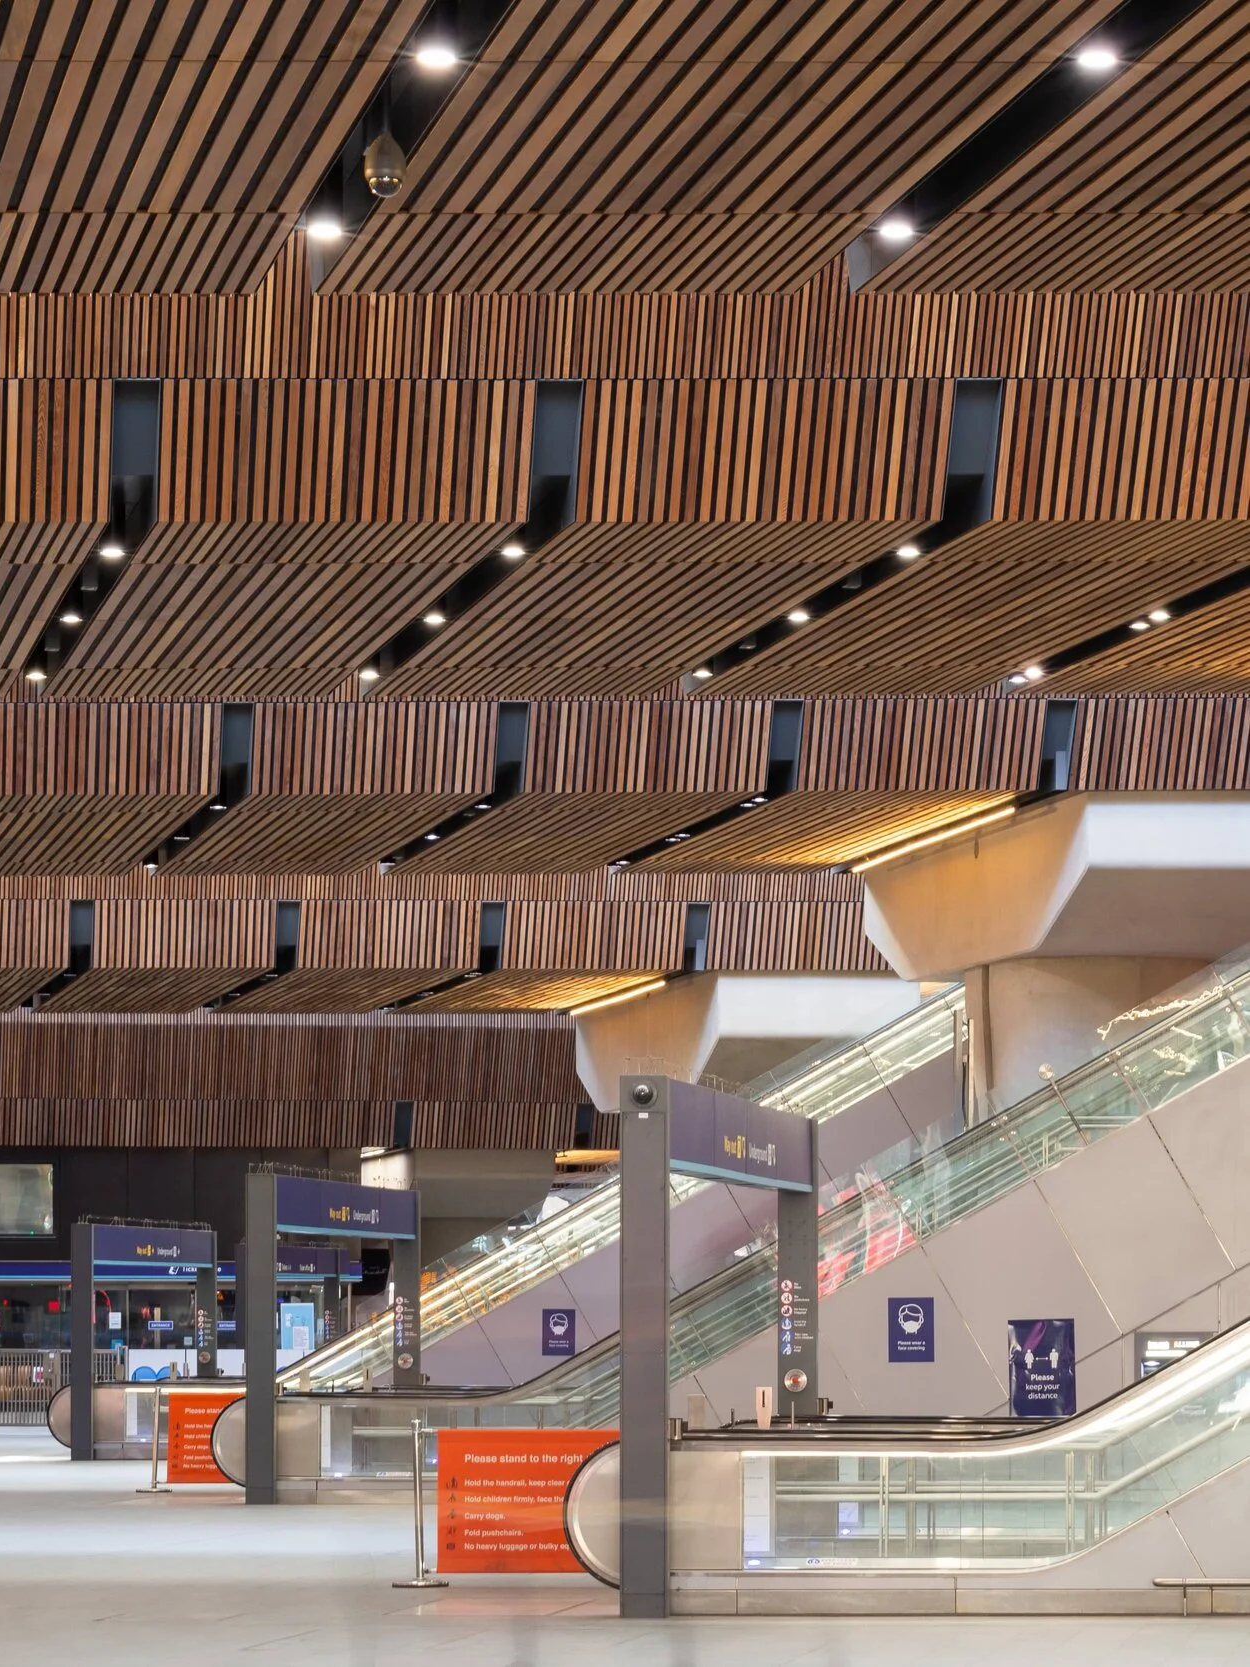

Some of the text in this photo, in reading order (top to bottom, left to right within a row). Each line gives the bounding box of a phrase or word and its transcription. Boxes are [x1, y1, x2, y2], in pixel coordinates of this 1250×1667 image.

[1025, 1383, 1042, 1391] keep
[464, 1454, 583, 1465] Please stand to the right
[464, 1479, 481, 1487] Hold
[495, 1479, 527, 1488] handrail,
[528, 1479, 546, 1488] keep
[547, 1479, 566, 1487] clear
[483, 1495, 511, 1503] children
[513, 1495, 536, 1504] firmly,
[485, 1512, 506, 1520] dogs.
[464, 1529, 524, 1538] Fold pushchairs.
[476, 1543, 497, 1551] heavy
[499, 1543, 528, 1552] luggage
[538, 1543, 559, 1551] bulky
